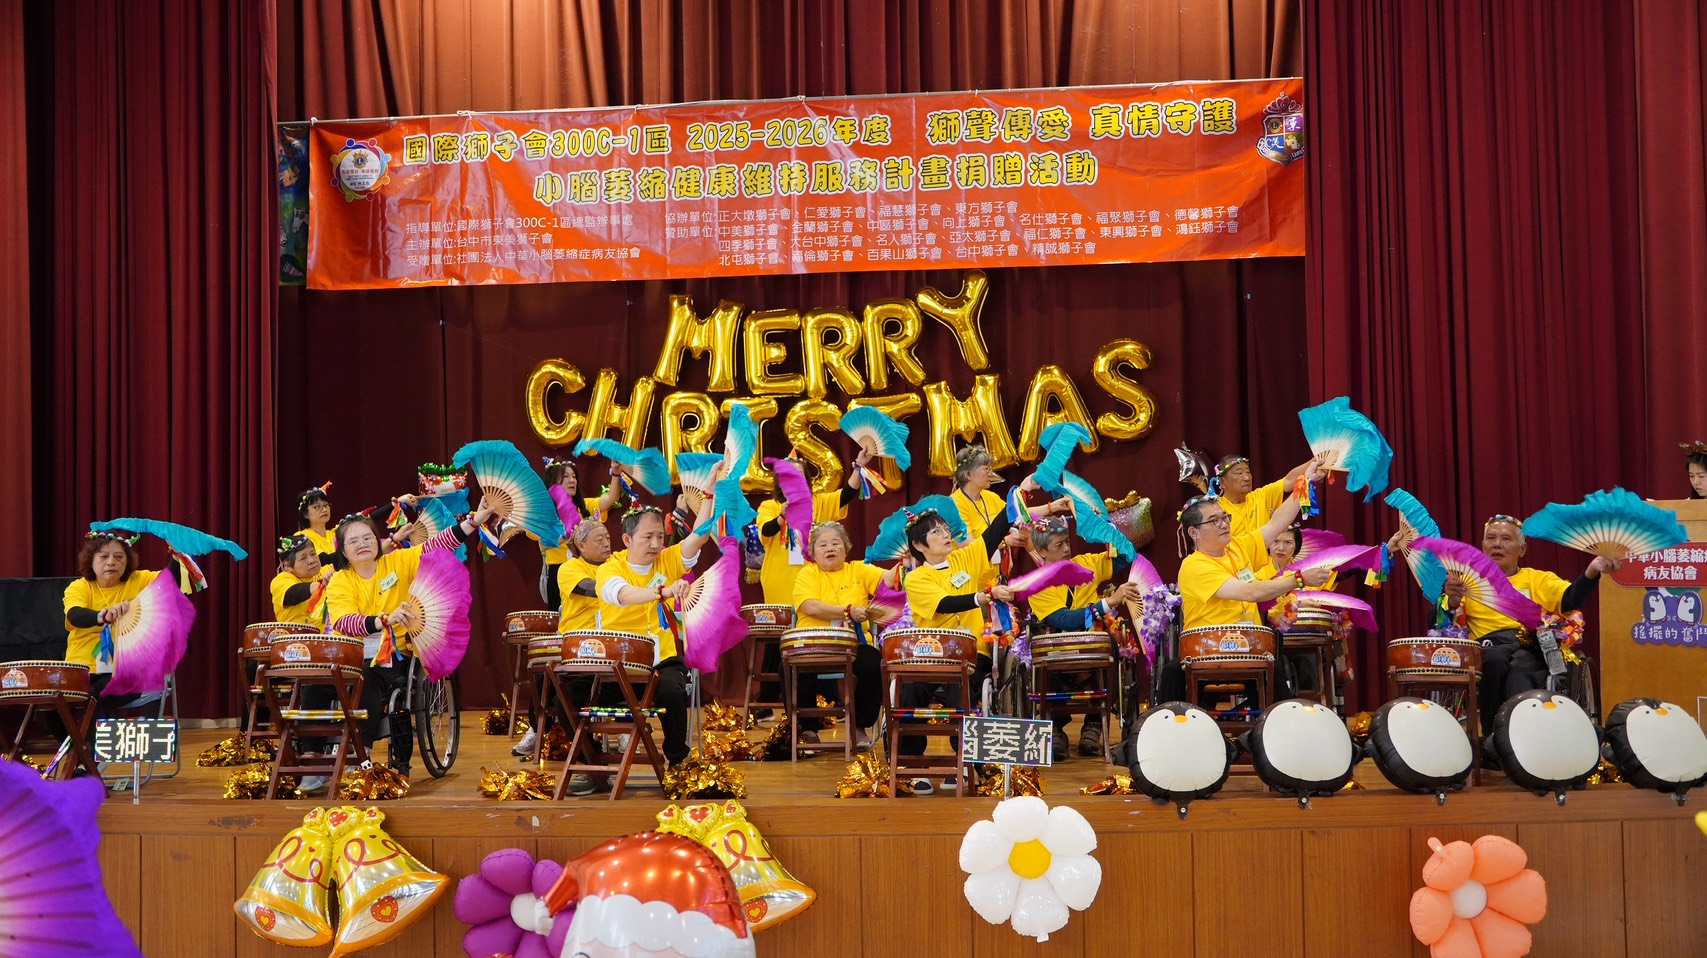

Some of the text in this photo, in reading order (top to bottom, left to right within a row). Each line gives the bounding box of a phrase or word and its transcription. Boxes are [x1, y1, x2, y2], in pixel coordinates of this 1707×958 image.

[405, 99, 1236, 163] 國際獅子會300C-1區 2025-2026年度 獅聲傳愛 真情守護
[535, 151, 1097, 205] 小腦萎縮健康維持服務計畫捐贈活動
[653, 269, 990, 398] MERRY
[525, 337, 1160, 495] CHRISTMAS
[1624, 548, 1707, 563] 中華小腦萎縮
[1643, 565, 1698, 580] 病友協會
